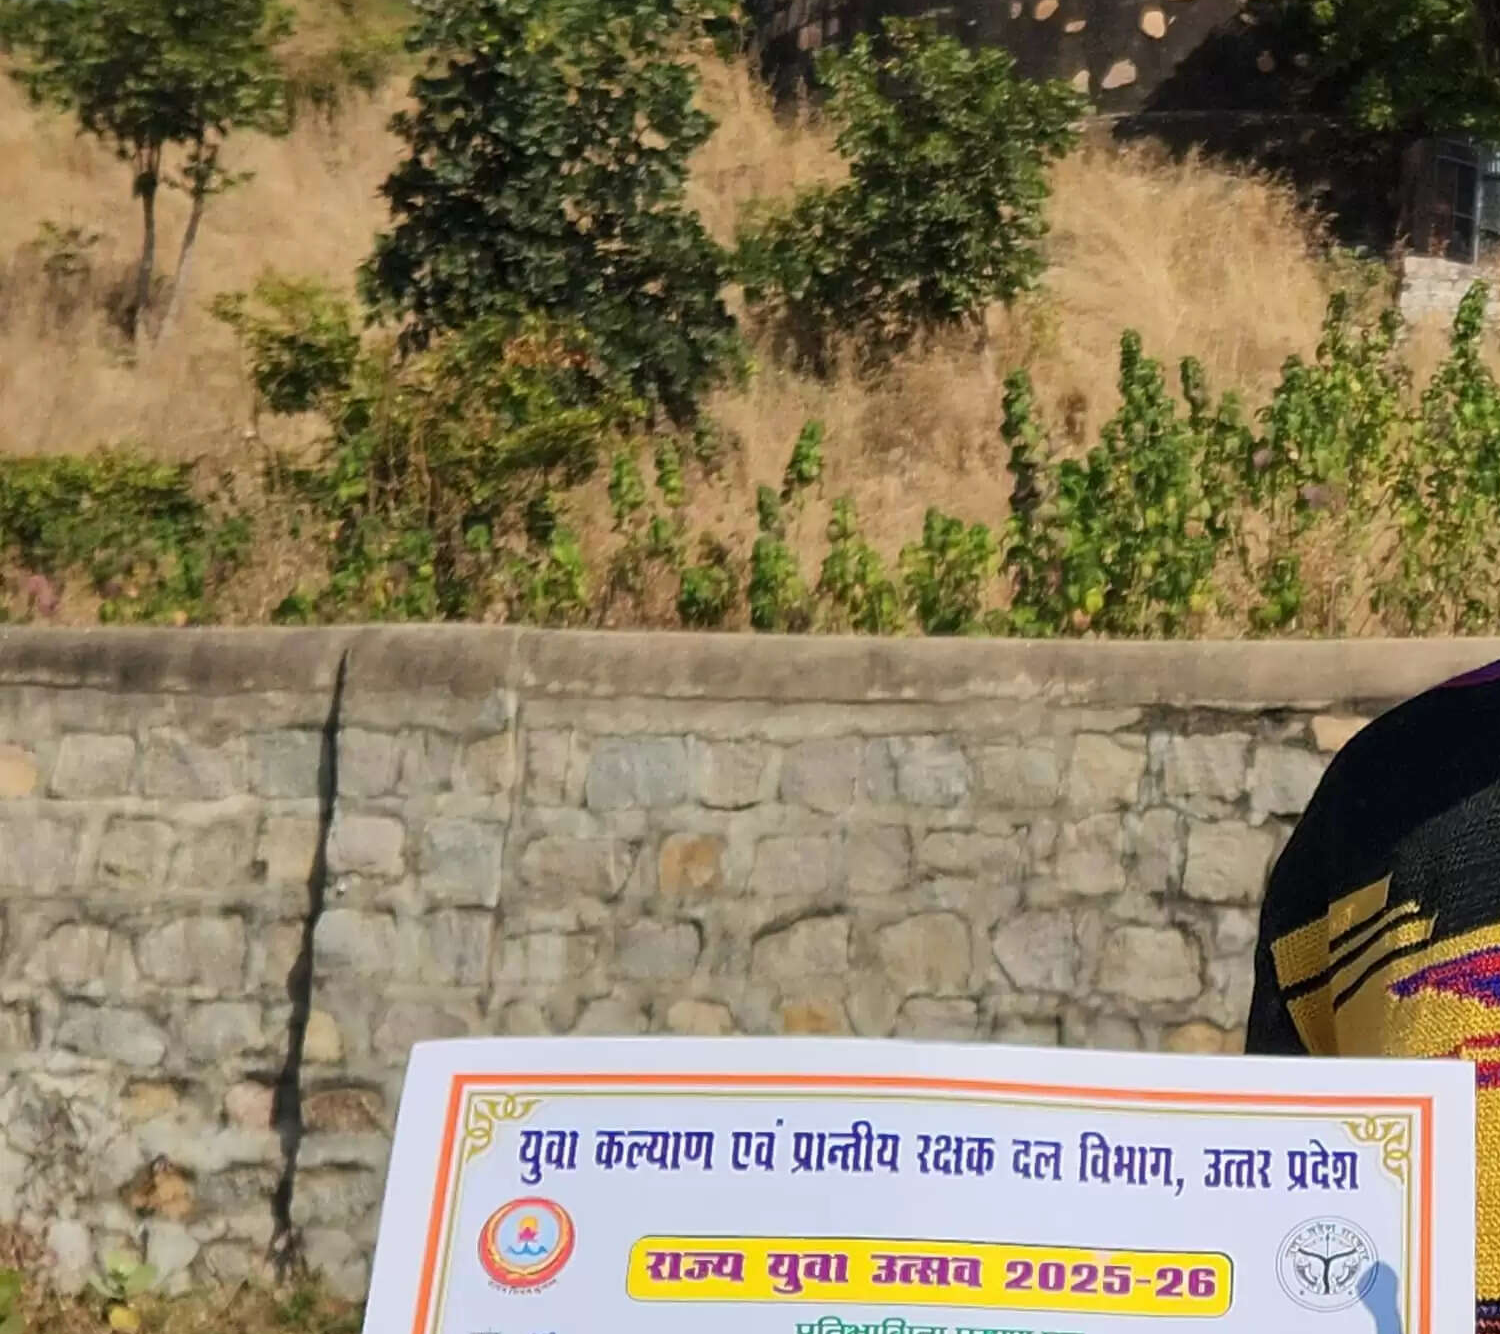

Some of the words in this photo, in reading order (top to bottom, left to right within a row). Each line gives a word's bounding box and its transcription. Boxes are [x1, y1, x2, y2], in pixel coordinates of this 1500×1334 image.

[519, 1130, 578, 1185] युवा
[595, 1130, 714, 1170] कल्याण
[732, 1118, 784, 1171] एवं
[791, 1121, 901, 1174] प्रान्तीय
[917, 1133, 995, 1176] रक्षक
[1012, 1138, 1063, 1181] दल
[1079, 1131, 1185, 1196] विभाग,
[1204, 1147, 1271, 1189] उत्तर
[1286, 1139, 1358, 1191] प्रदेश
[646, 1251, 744, 1281] राज्य
[767, 1252, 849, 1294] युवा
[870, 1254, 982, 1289] उत्सव
[1005, 1259, 1216, 1298] 2025-26
